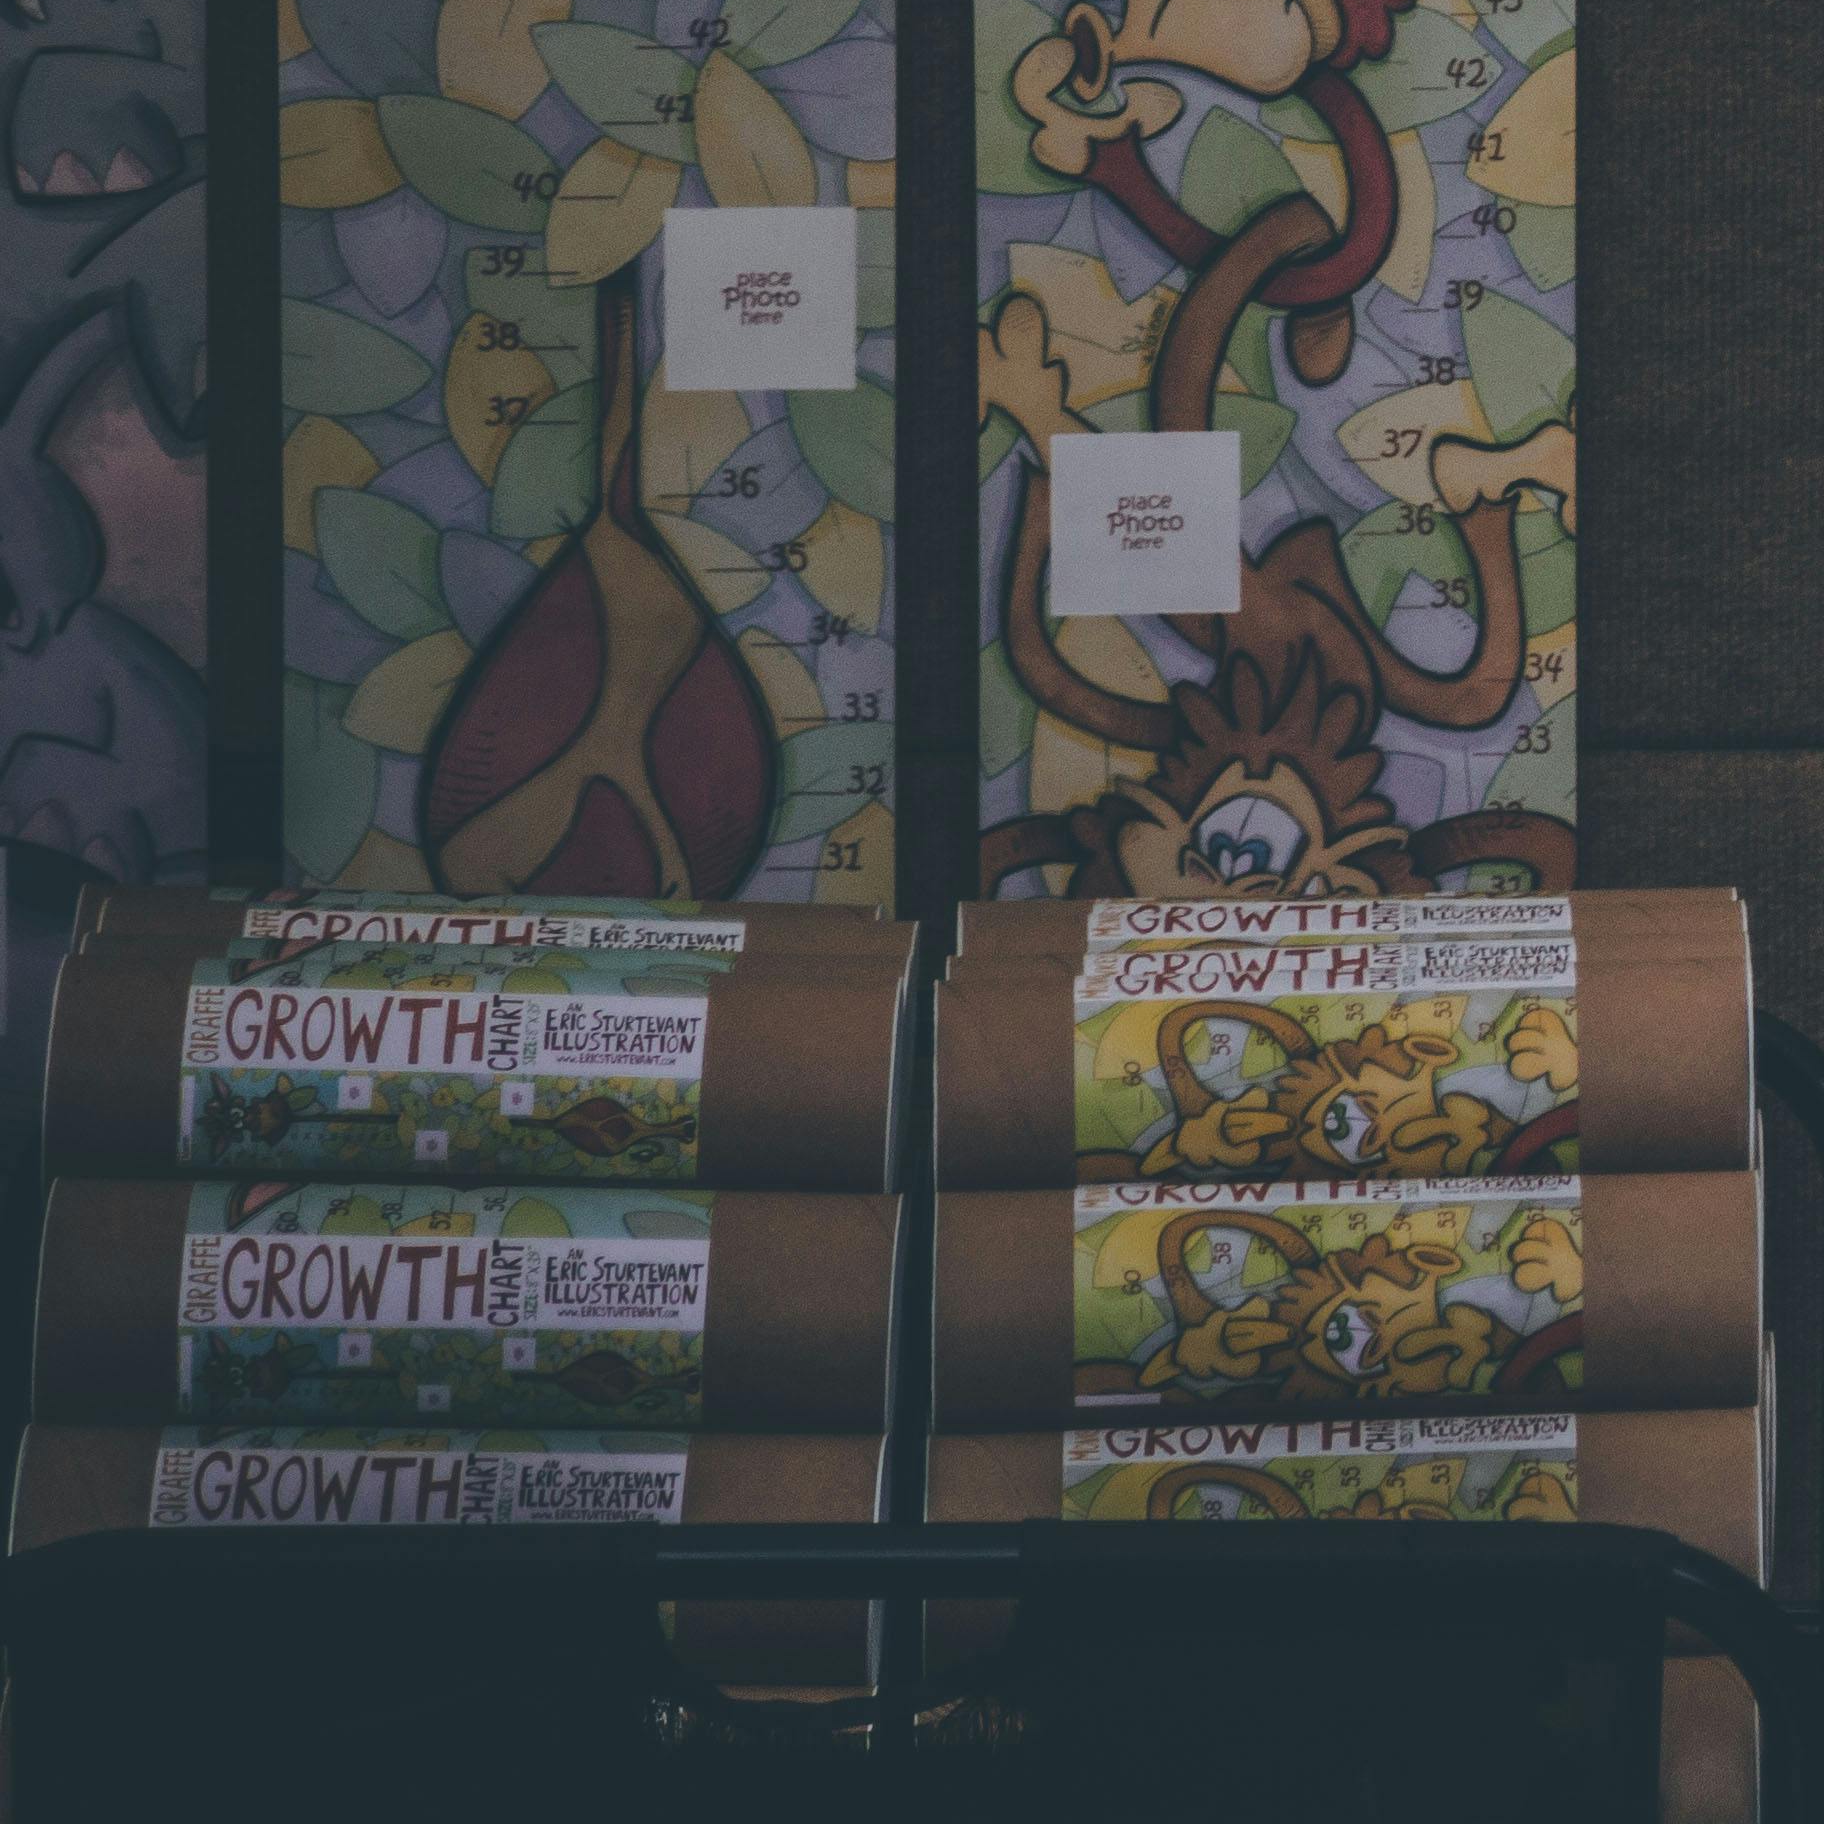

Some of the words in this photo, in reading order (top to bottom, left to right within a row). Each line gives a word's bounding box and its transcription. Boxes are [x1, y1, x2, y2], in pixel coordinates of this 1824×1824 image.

[736, 269, 793, 290] place
[721, 287, 801, 311] Photo
[741, 308, 784, 326] here
[1116, 492, 1173, 513] place
[1106, 509, 1185, 535] Photo
[1121, 531, 1164, 551] here
[1126, 903, 1368, 934] GROWTH
[187, 987, 226, 1064] GIRAFFE
[226, 989, 488, 1064] GROWTH
[488, 994, 524, 1072] CHART
[546, 1008, 587, 1032] ERIC
[592, 1009, 702, 1034] STURTEVANT
[544, 1031, 696, 1053] ILLUSTRATION
[567, 1248, 583, 1260] AN
[183, 1236, 221, 1324] GIRAFFE
[222, 1237, 488, 1321] GROWTH
[487, 1239, 524, 1327] CHART
[546, 1256, 588, 1283] ERIC
[592, 1256, 705, 1284] STURTEVANT
[544, 1283, 698, 1305] ILLUSTRATION
[1104, 1420, 1363, 1458] GROWTH
[154, 1448, 196, 1525] GIRAFFE
[193, 1451, 464, 1523] GROWTH
[460, 1451, 501, 1526] CHART
[521, 1465, 562, 1491] ERIC
[567, 1463, 678, 1491] STURTEVANT
[517, 1487, 674, 1510] ILLUSTRATION
